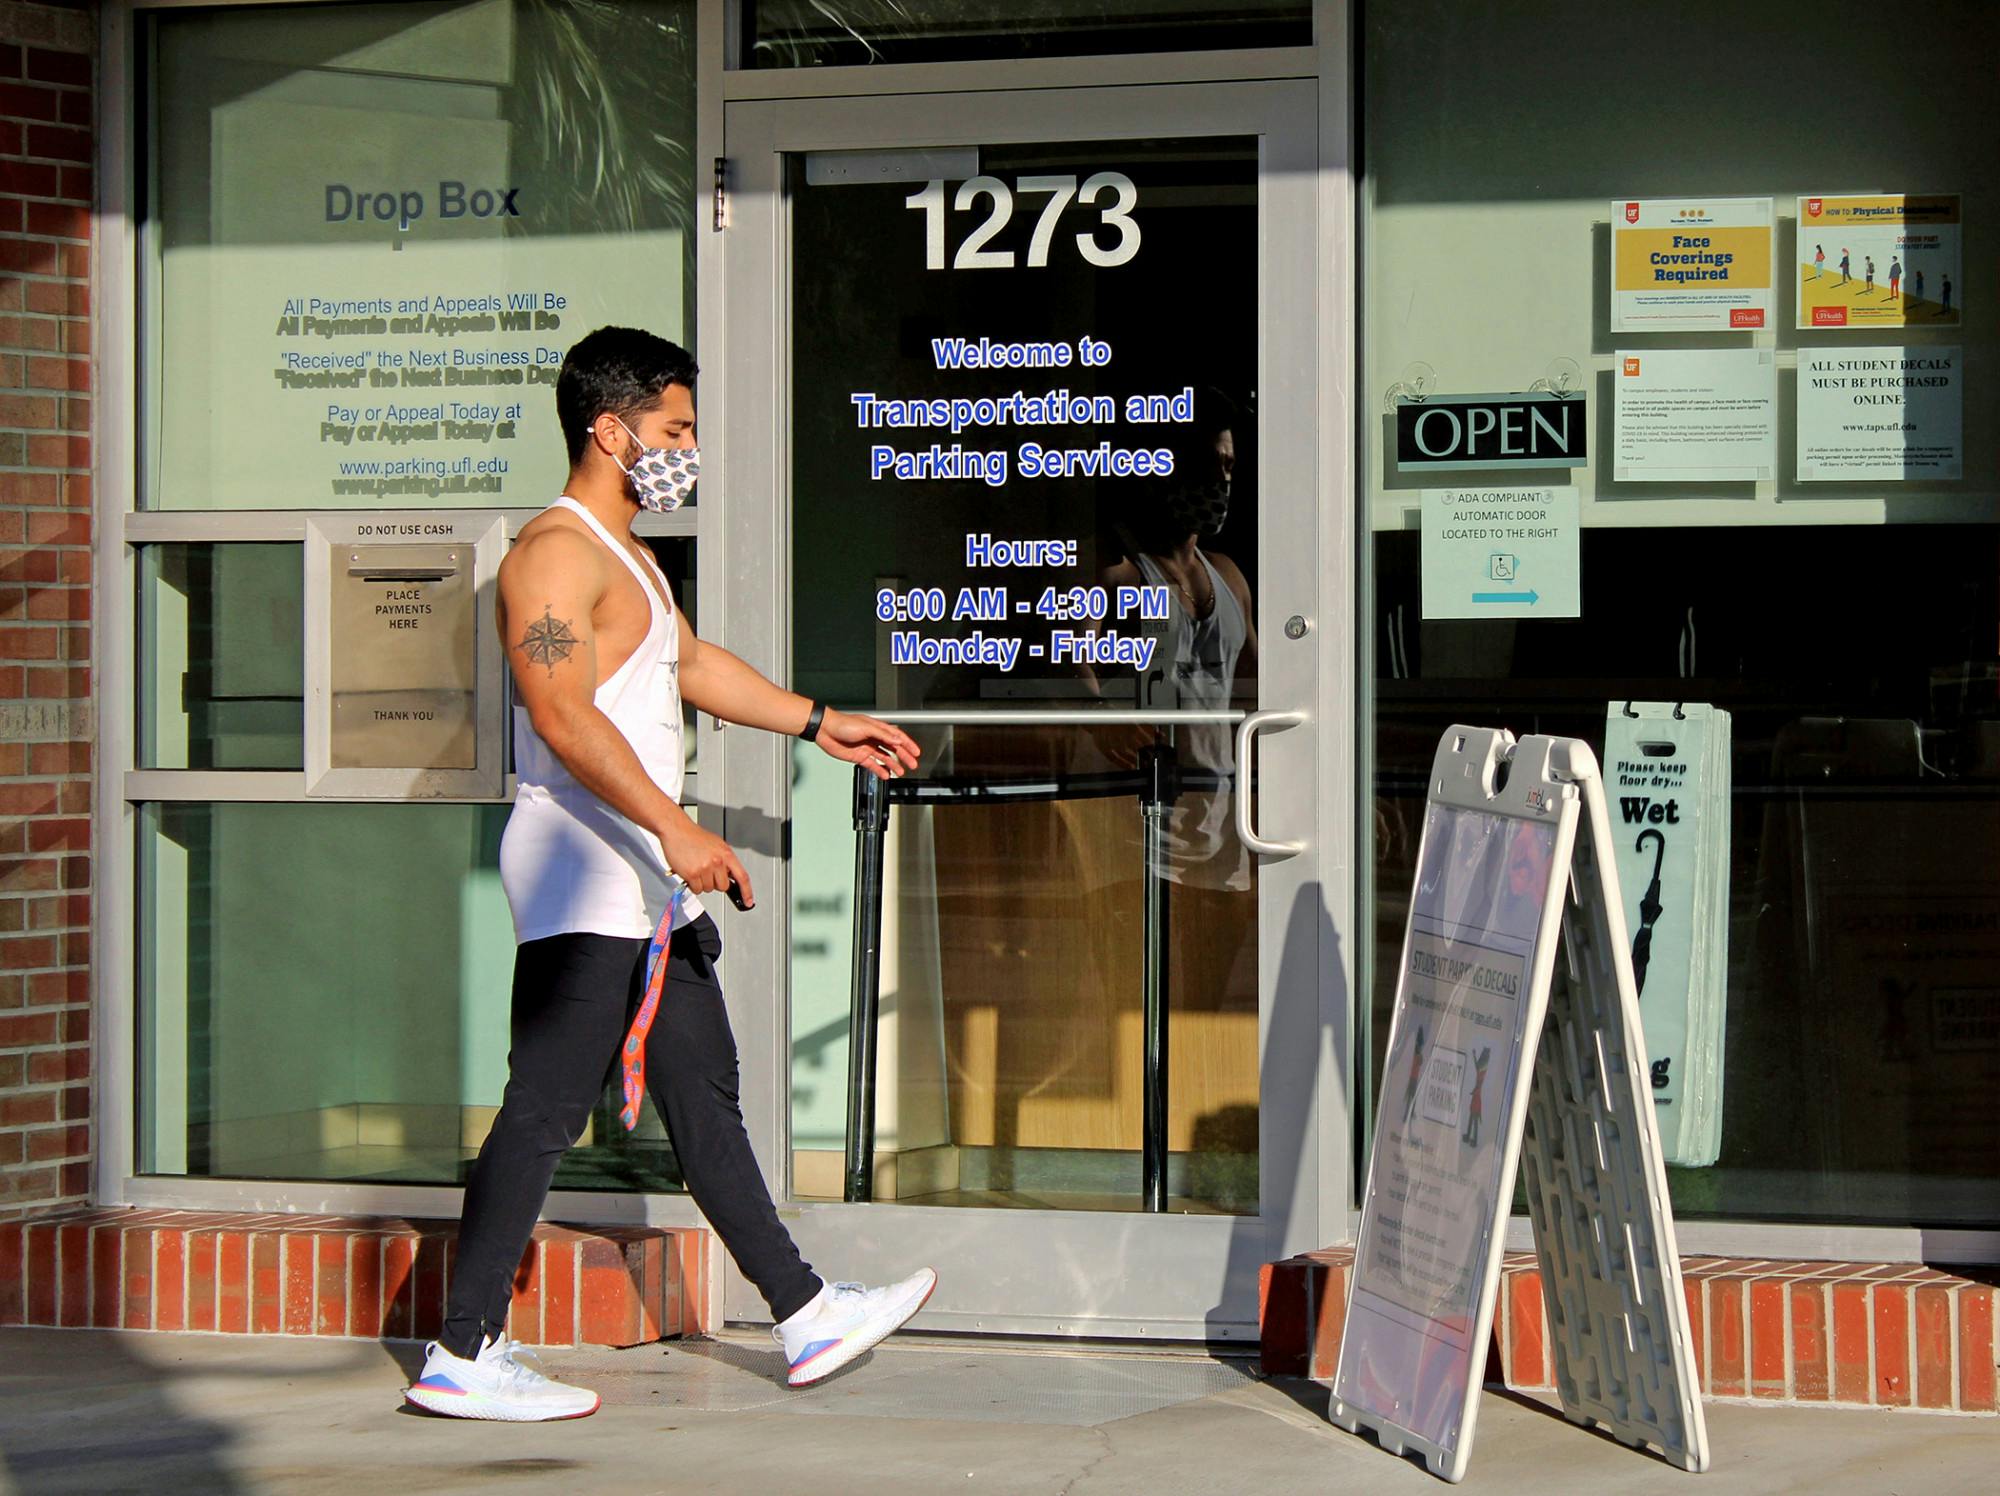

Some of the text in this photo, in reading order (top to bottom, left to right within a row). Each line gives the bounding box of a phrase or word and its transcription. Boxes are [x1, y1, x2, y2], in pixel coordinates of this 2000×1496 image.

[325, 181, 520, 232] Drop Box
[1853, 206, 1894, 216] Physical
[906, 171, 1141, 270] 1273
[1673, 236, 1710, 248] Face
[1650, 251, 1733, 266] Coverings
[1654, 268, 1728, 284] Required
[284, 293, 567, 318] All Payments and Appeals Will Be
[281, 350, 372, 369] "Received"
[377, 350, 402, 367] the
[409, 350, 447, 366] Next
[453, 348, 529, 366] Business
[932, 336, 1112, 369] Welcome to
[1625, 364, 1636, 372] UF
[1810, 358, 1951, 372] ALL STUDENT DECALS
[1812, 376, 1950, 388] MUST BE PURCHASED
[1853, 394, 1906, 406] ONLINE.
[328, 402, 521, 425] Pay or Appeal Today at
[851, 387, 1194, 434] Transportation and
[1414, 406, 1569, 457] OPEN
[340, 458, 508, 478] www.parking.ufl.edu
[870, 441, 1174, 487] Parking Services
[1458, 492, 1540, 503] ADA COMPLIANT
[1453, 510, 1546, 521] AUTOMATIC DOOR
[358, 524, 454, 536] DO NOT USE CASH
[1442, 528, 1558, 540] LOCATED TO THE RIGHT
[965, 534, 1078, 567] Hours:
[386, 590, 420, 600] PLACE
[375, 604, 432, 615] PAYMENTS
[876, 586, 1170, 622] 8:00 AM - 4:30 PM
[389, 619, 418, 630] HERE
[891, 628, 1157, 672] Monday - Friday
[374, 710, 434, 721] THANK YOU
[1617, 761, 1687, 775] Please keep
[1619, 775, 1648, 786] floor
[1620, 796, 1680, 824] Wet
